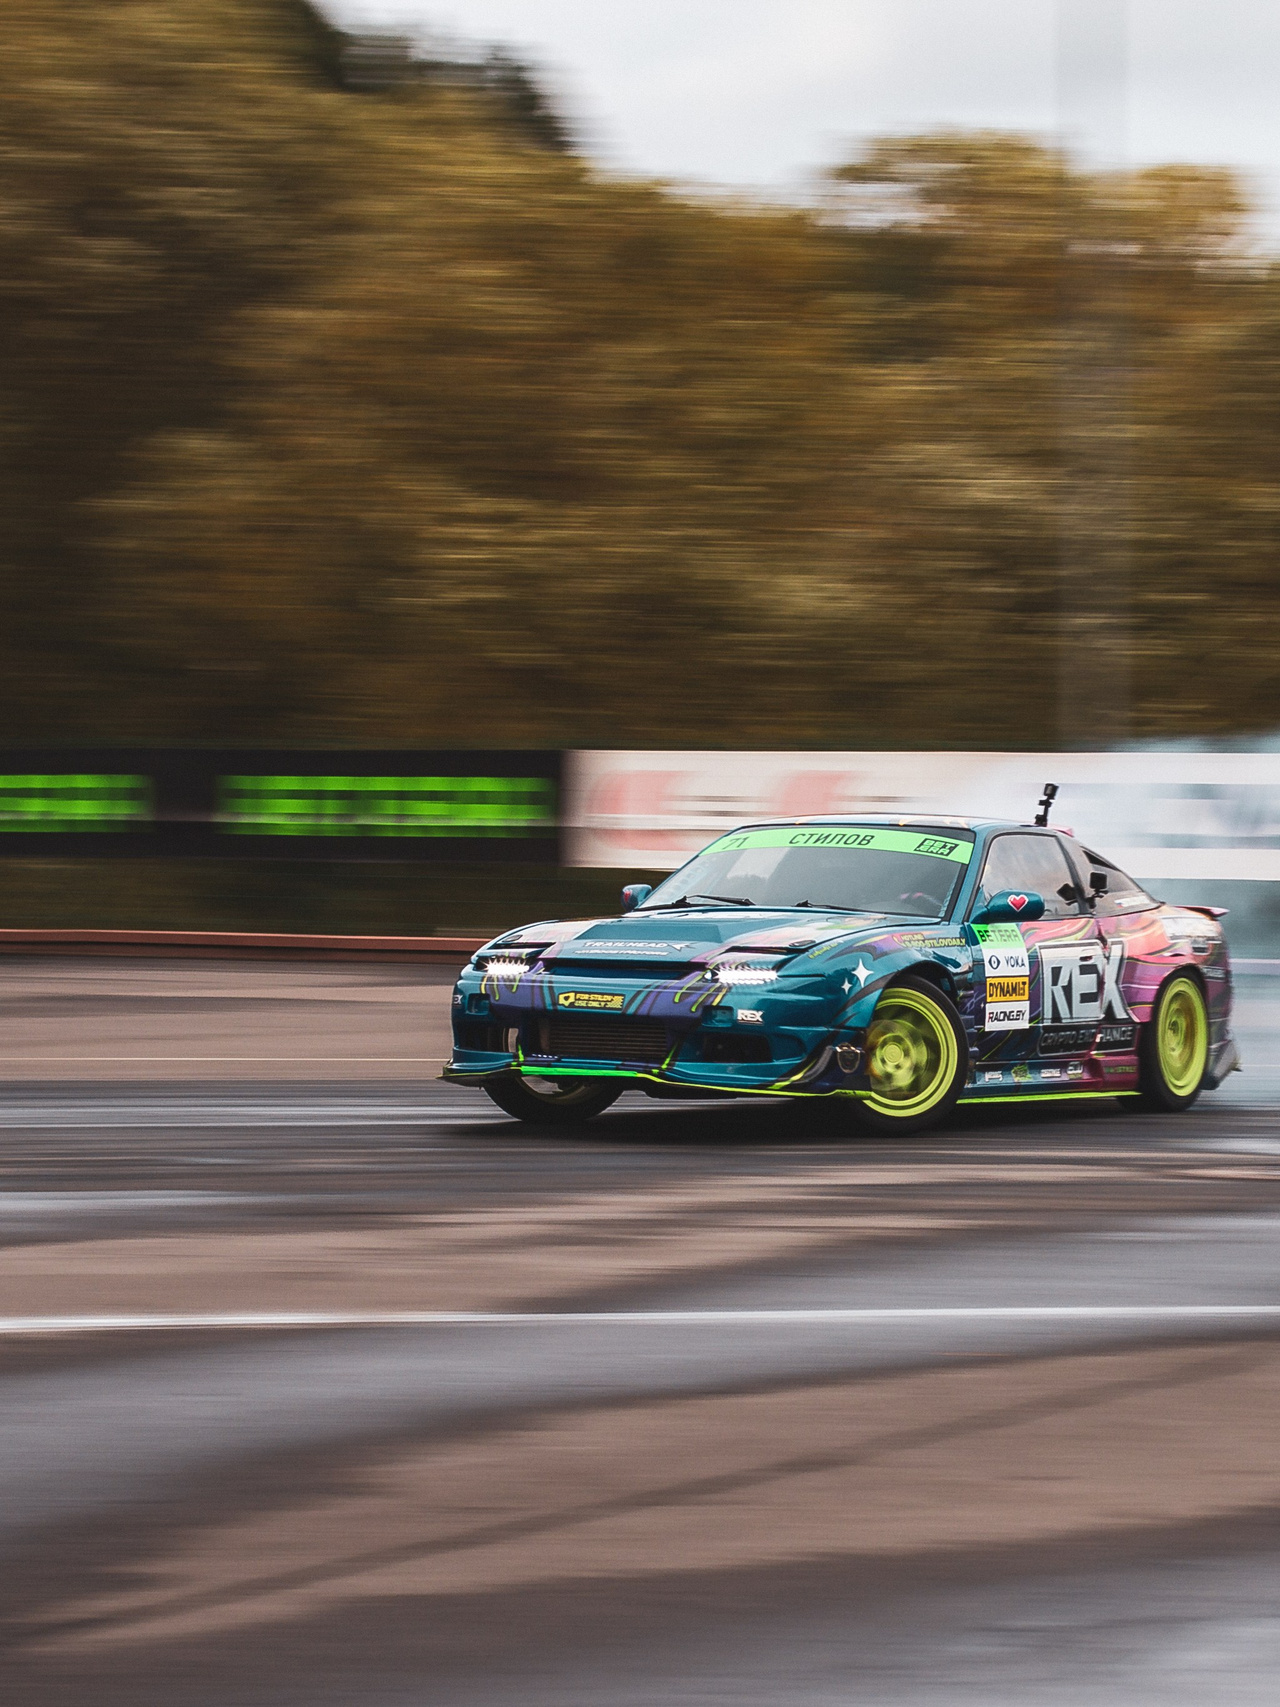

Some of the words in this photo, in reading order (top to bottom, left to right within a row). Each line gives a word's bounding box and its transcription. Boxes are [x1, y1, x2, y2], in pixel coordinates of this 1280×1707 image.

[722, 836, 750, 850] 71
[788, 833, 876, 846] СТИЛОВ
[1040, 944, 1130, 1024] REX
[737, 1009, 765, 1022] REX
